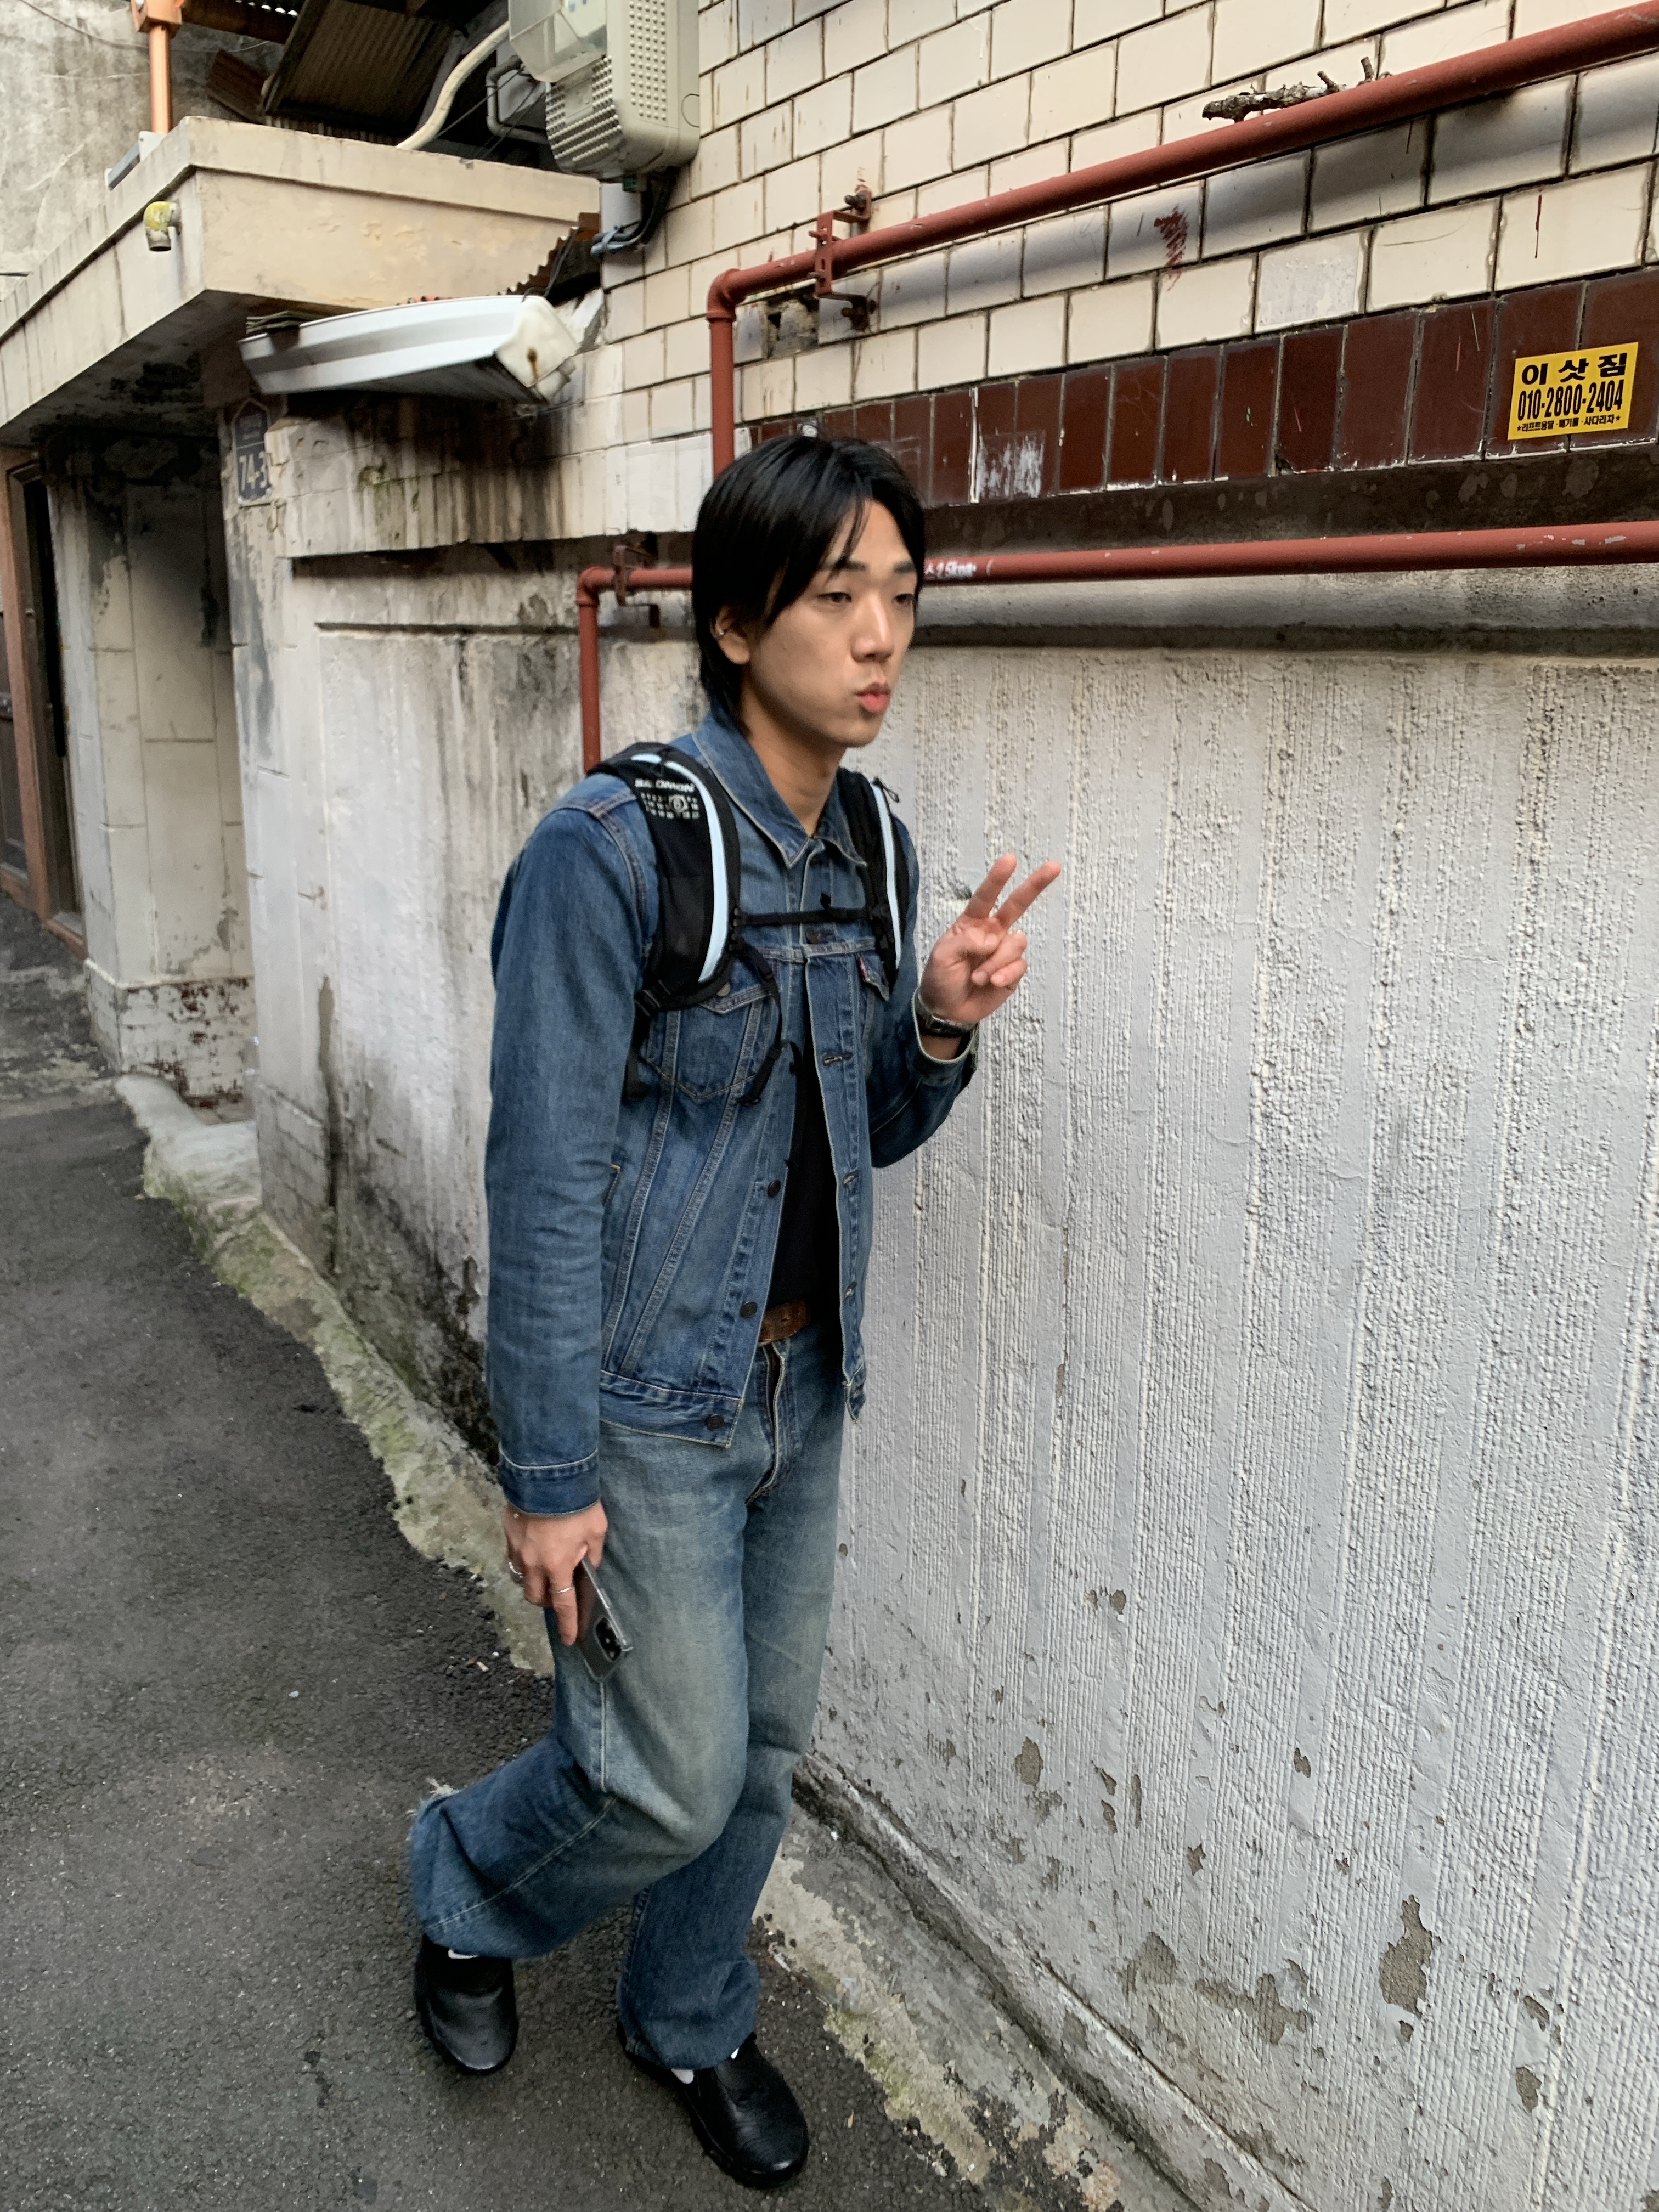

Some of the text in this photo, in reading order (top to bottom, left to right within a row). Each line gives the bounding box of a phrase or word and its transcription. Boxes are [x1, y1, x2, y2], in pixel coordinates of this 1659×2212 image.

[1522, 353, 1627, 385] 이삿짐
[1518, 380, 1624, 420] 010-2800-2404
[1583, 415, 1615, 426] 사다리차
